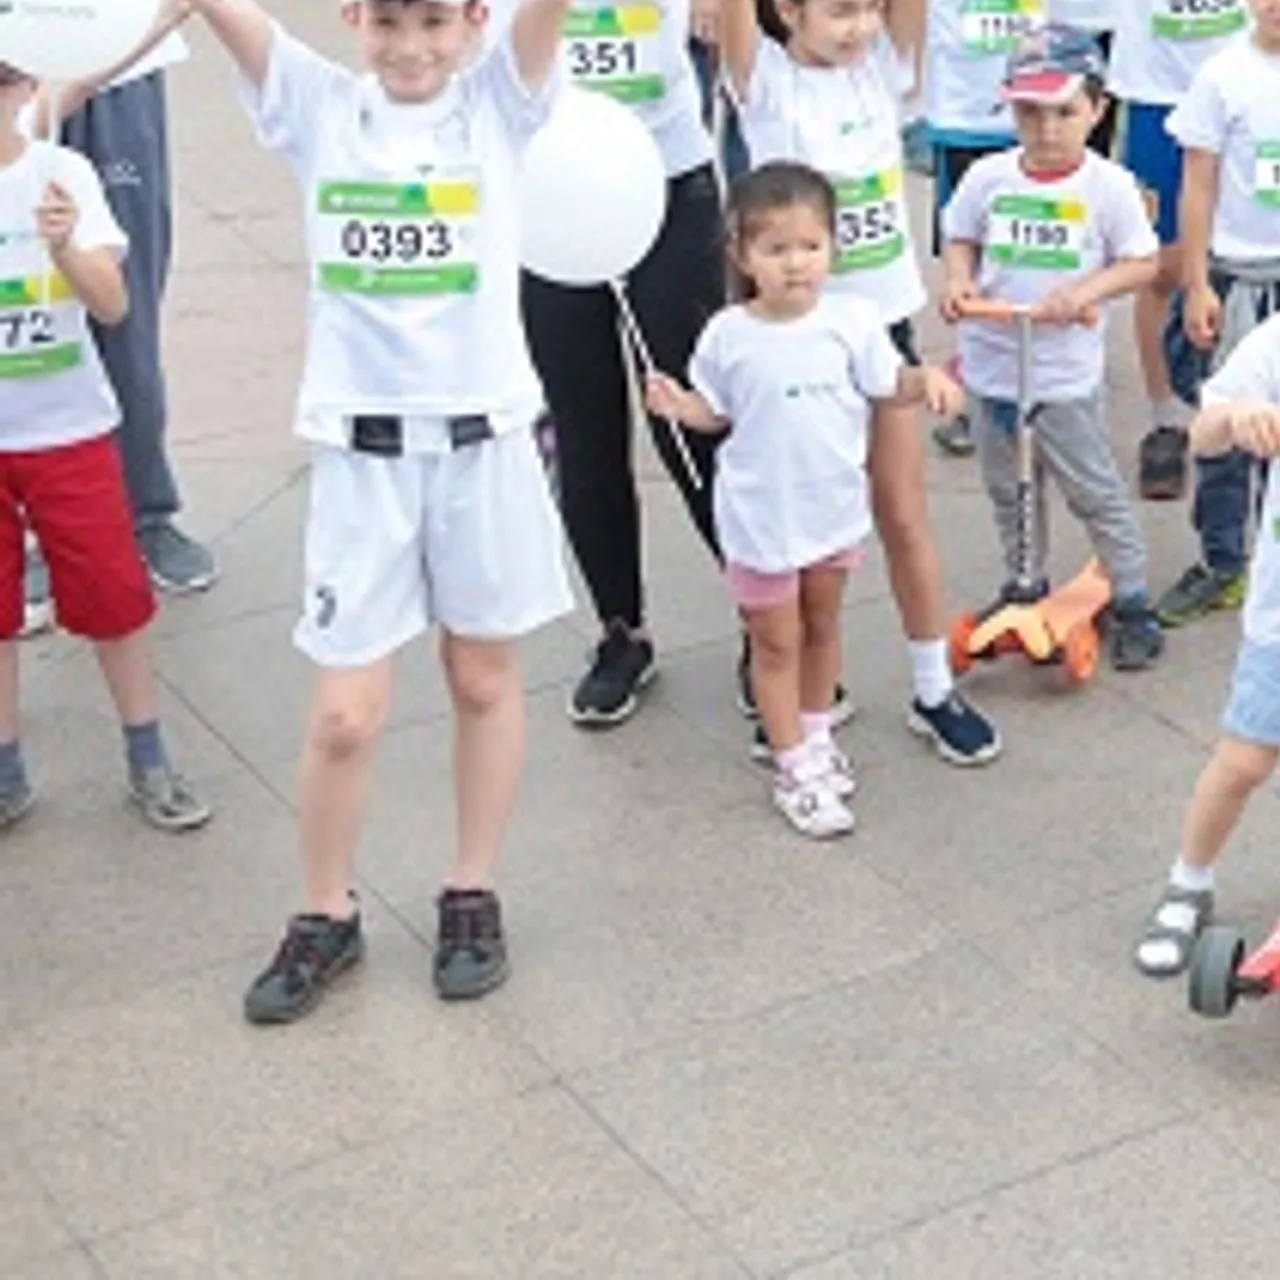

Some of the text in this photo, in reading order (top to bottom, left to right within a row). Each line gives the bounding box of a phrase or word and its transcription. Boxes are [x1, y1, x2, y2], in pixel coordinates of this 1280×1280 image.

[571, 42, 637, 75] 351
[342, 220, 454, 263] 0393
[0, 310, 54, 349] 72
